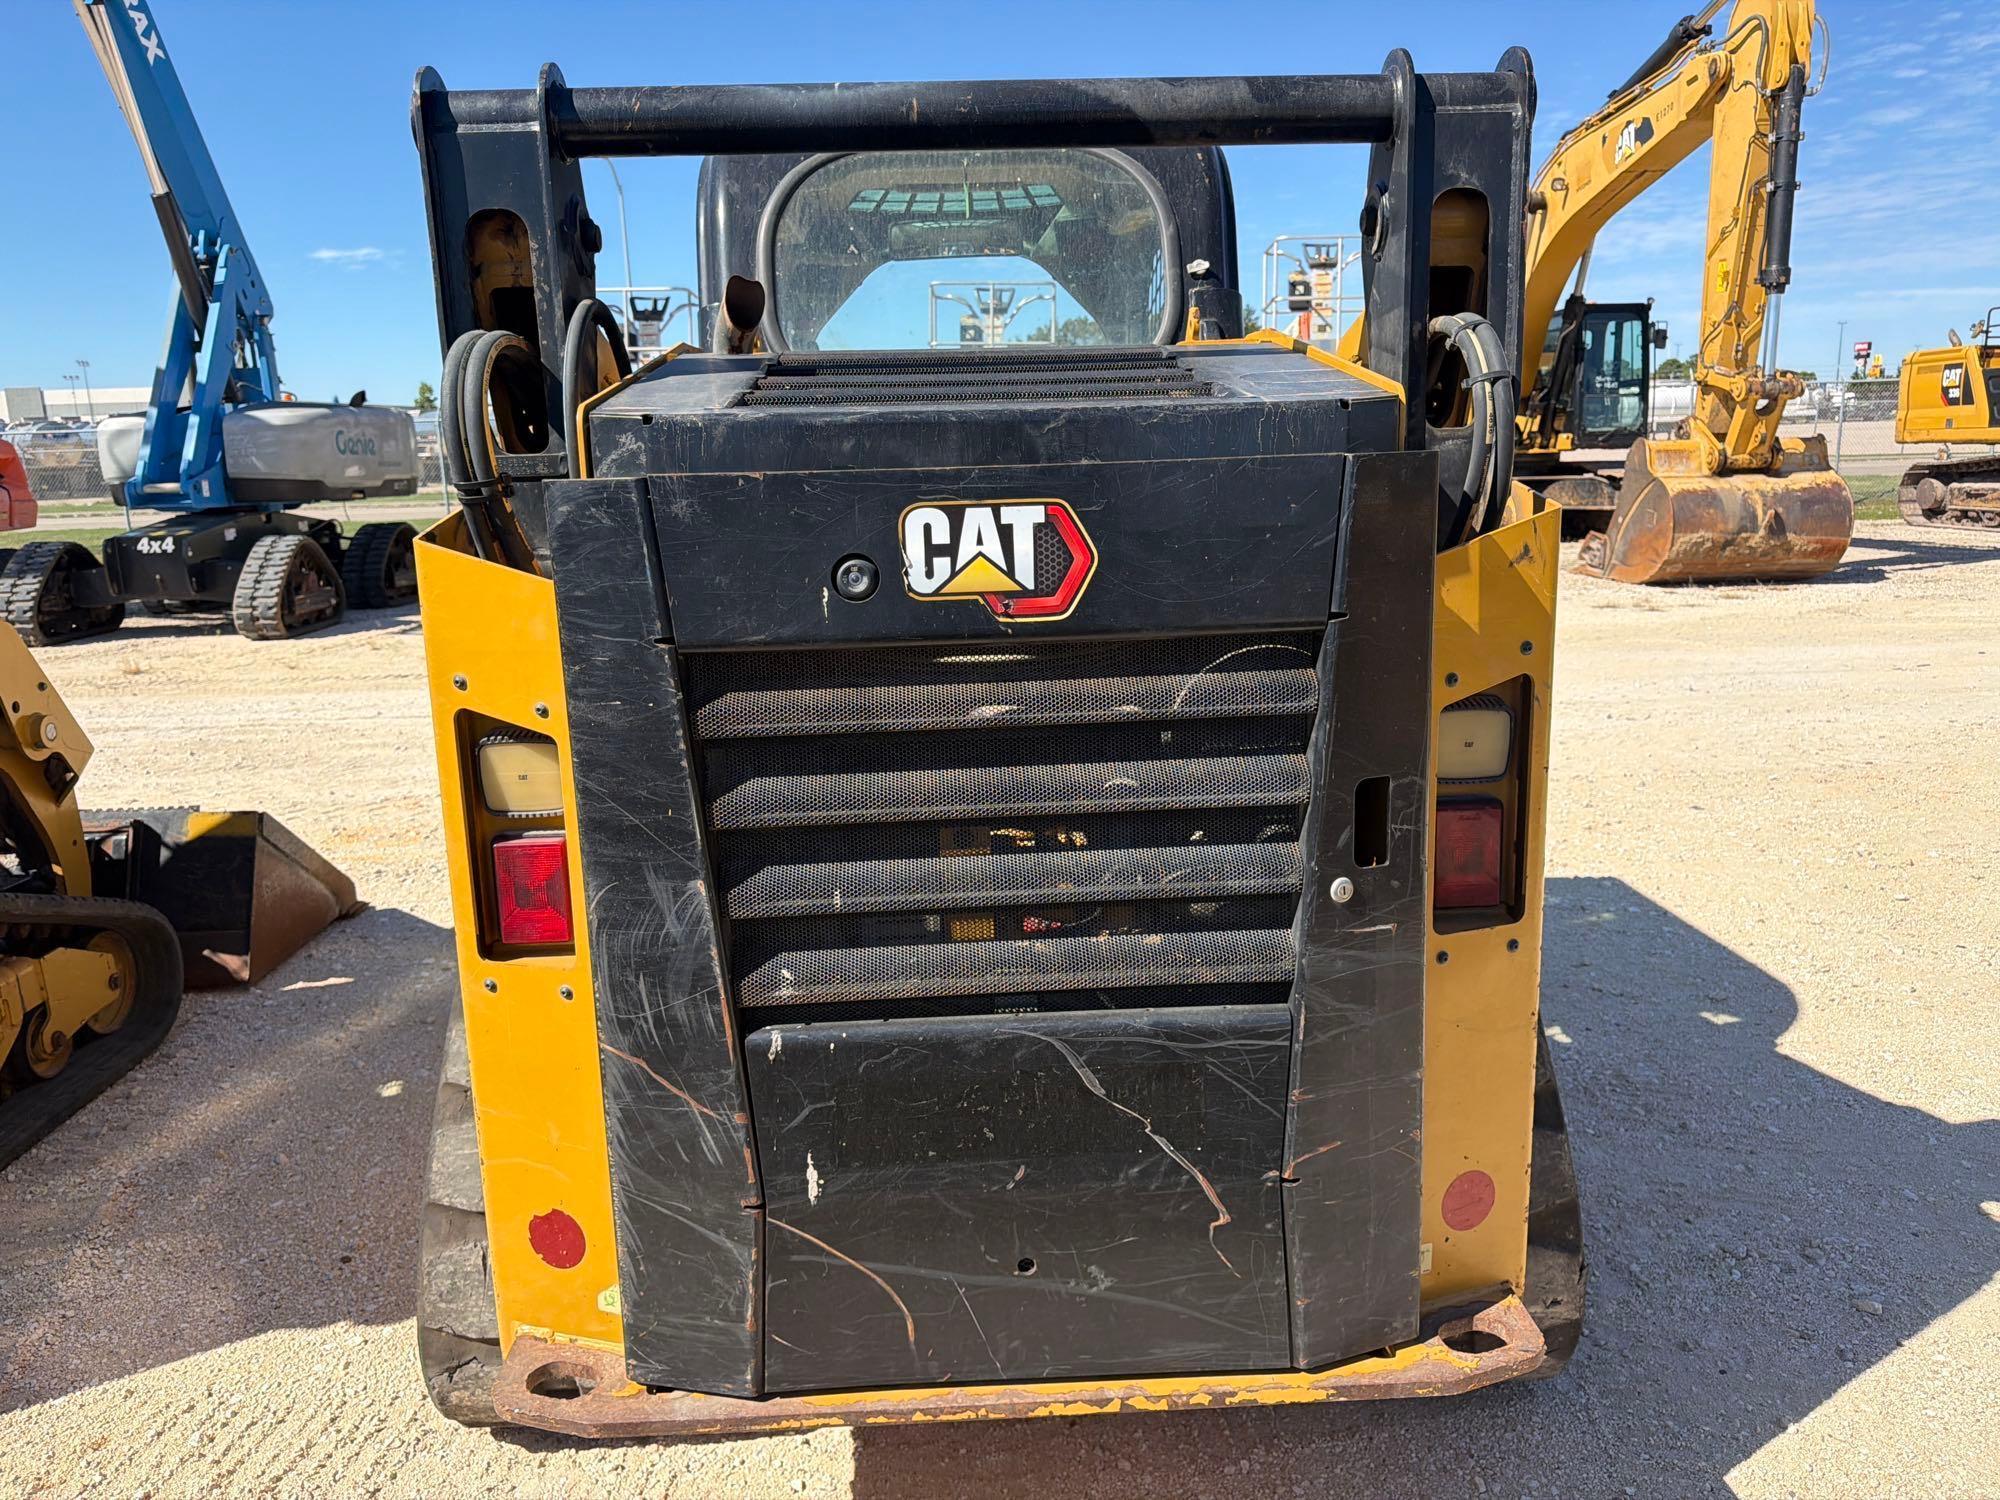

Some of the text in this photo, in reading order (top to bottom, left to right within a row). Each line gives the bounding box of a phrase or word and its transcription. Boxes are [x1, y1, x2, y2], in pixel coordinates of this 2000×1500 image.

[1942, 368, 1962, 387] CAT
[335, 430, 376, 456] Genie
[136, 536, 175, 554] 4x4
[904, 504, 1046, 595] CAT
